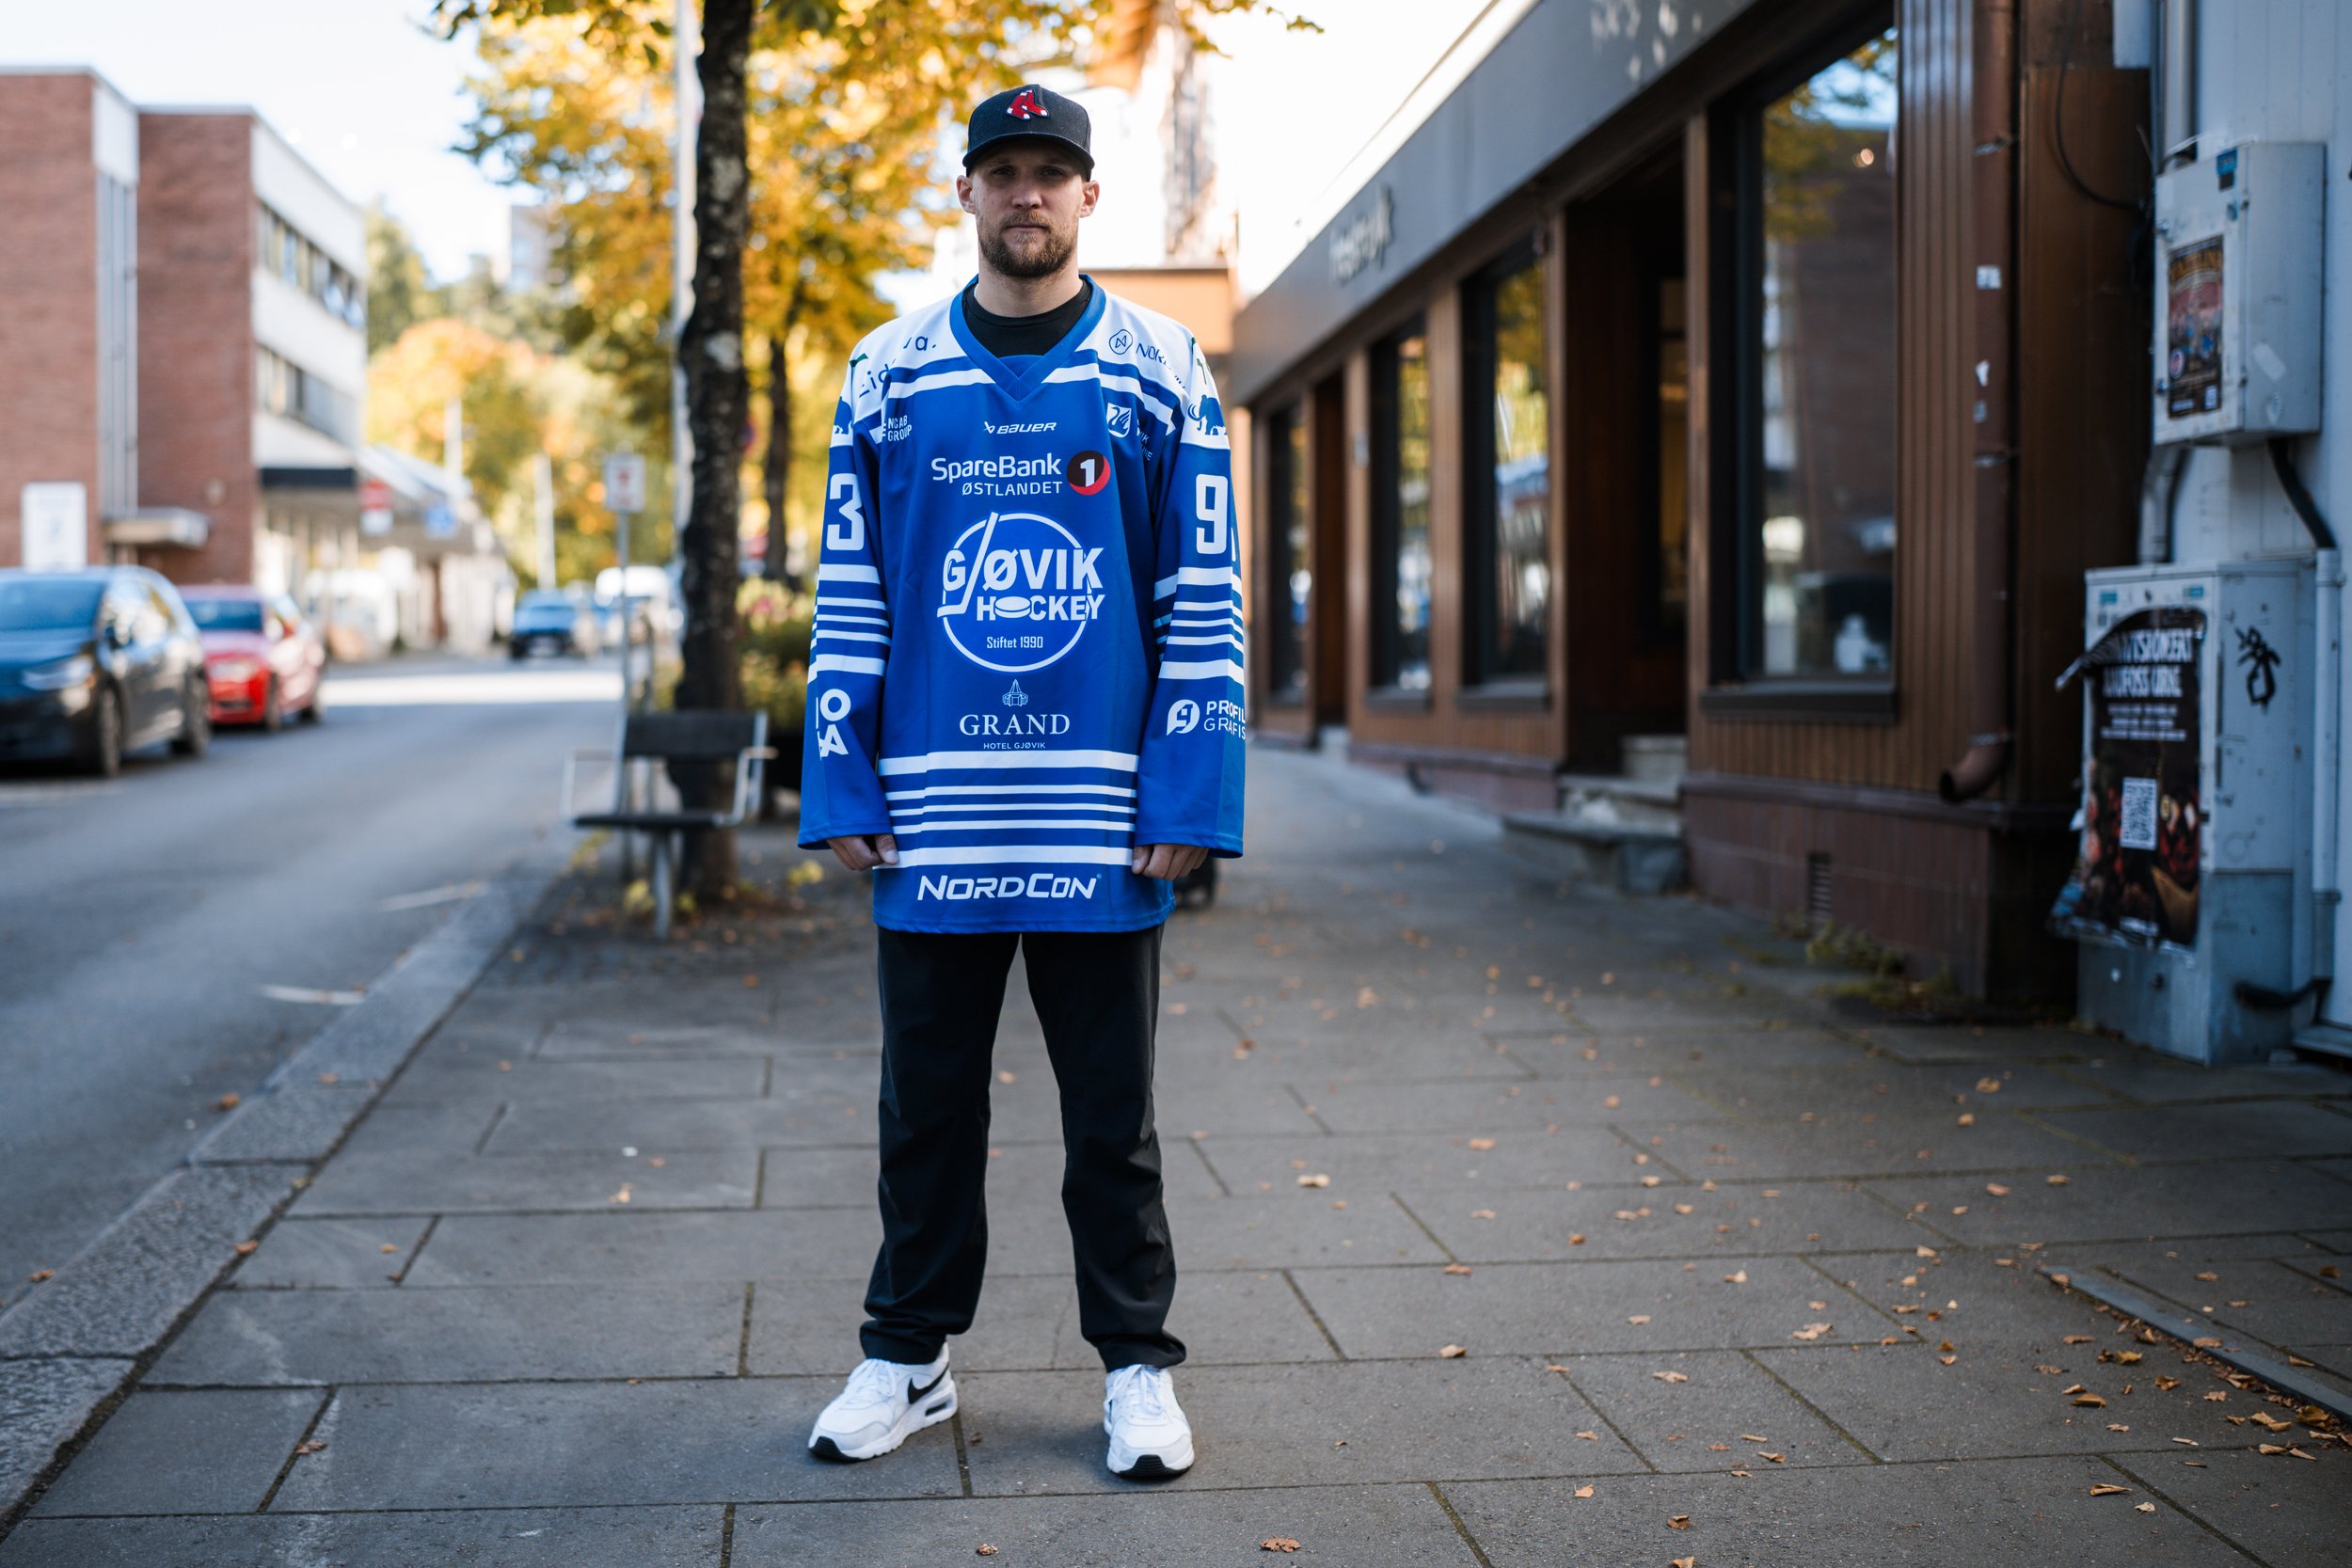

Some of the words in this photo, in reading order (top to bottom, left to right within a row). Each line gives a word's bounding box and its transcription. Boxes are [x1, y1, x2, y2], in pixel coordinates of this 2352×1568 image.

[996, 421, 1057, 435] BAUER
[930, 452, 1062, 484] SpareBank
[1079, 458, 1096, 487] 1
[961, 481, 1063, 497] ØSTLANDET
[826, 472, 865, 551] 3
[976, 594, 1106, 622] HOCKEY
[986, 636, 1017, 649] Stiftet
[1019, 636, 1044, 649] 1990
[959, 714, 1071, 736] GRAND
[1013, 741, 1046, 750] GJØVIK
